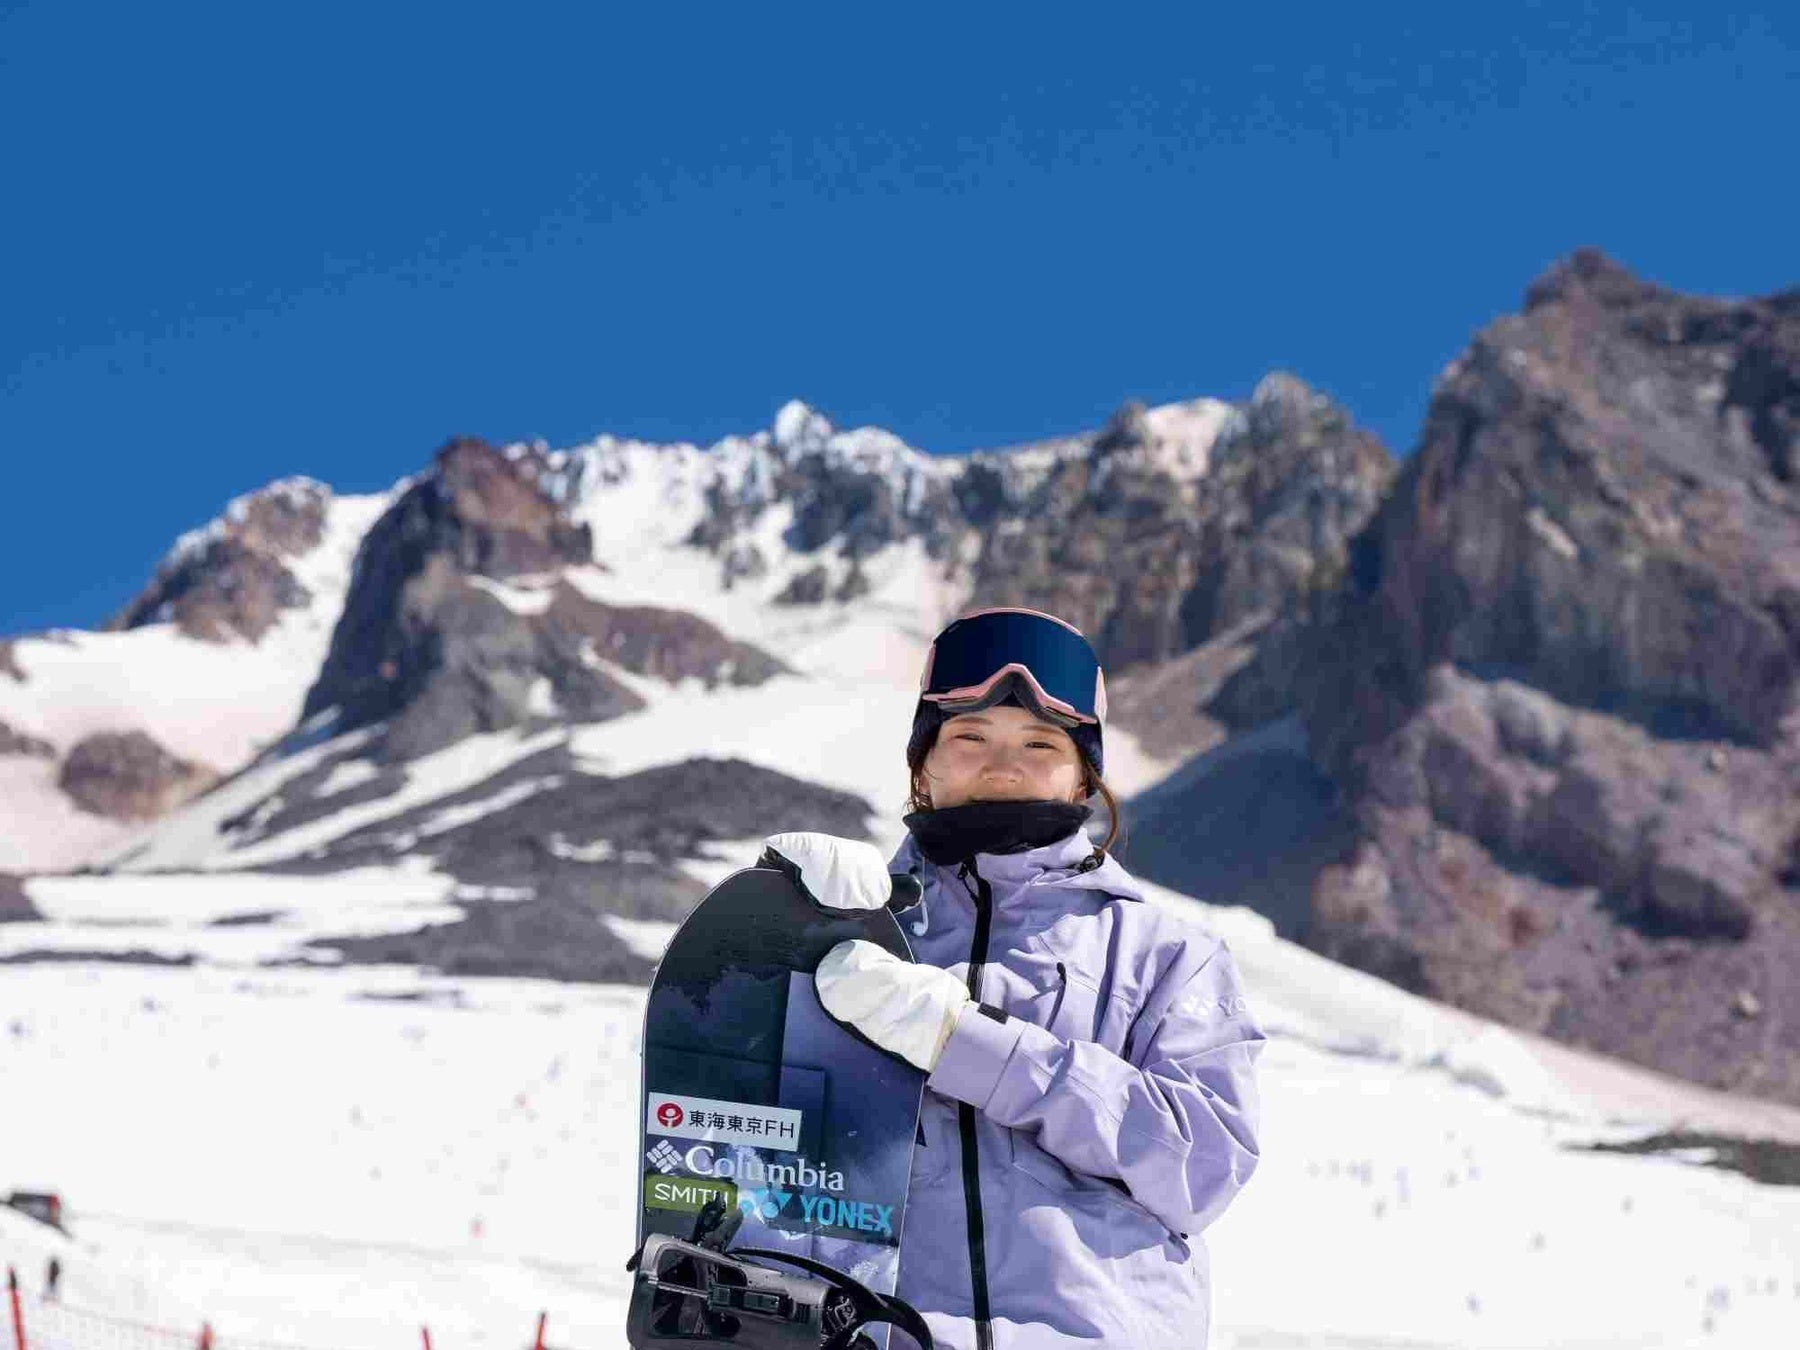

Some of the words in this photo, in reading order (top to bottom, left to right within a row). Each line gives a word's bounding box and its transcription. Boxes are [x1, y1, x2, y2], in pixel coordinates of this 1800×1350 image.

[688, 1109, 795, 1139] 東海東京FH
[685, 1145, 844, 1191] Columbia
[800, 1195, 894, 1235] YONEX
